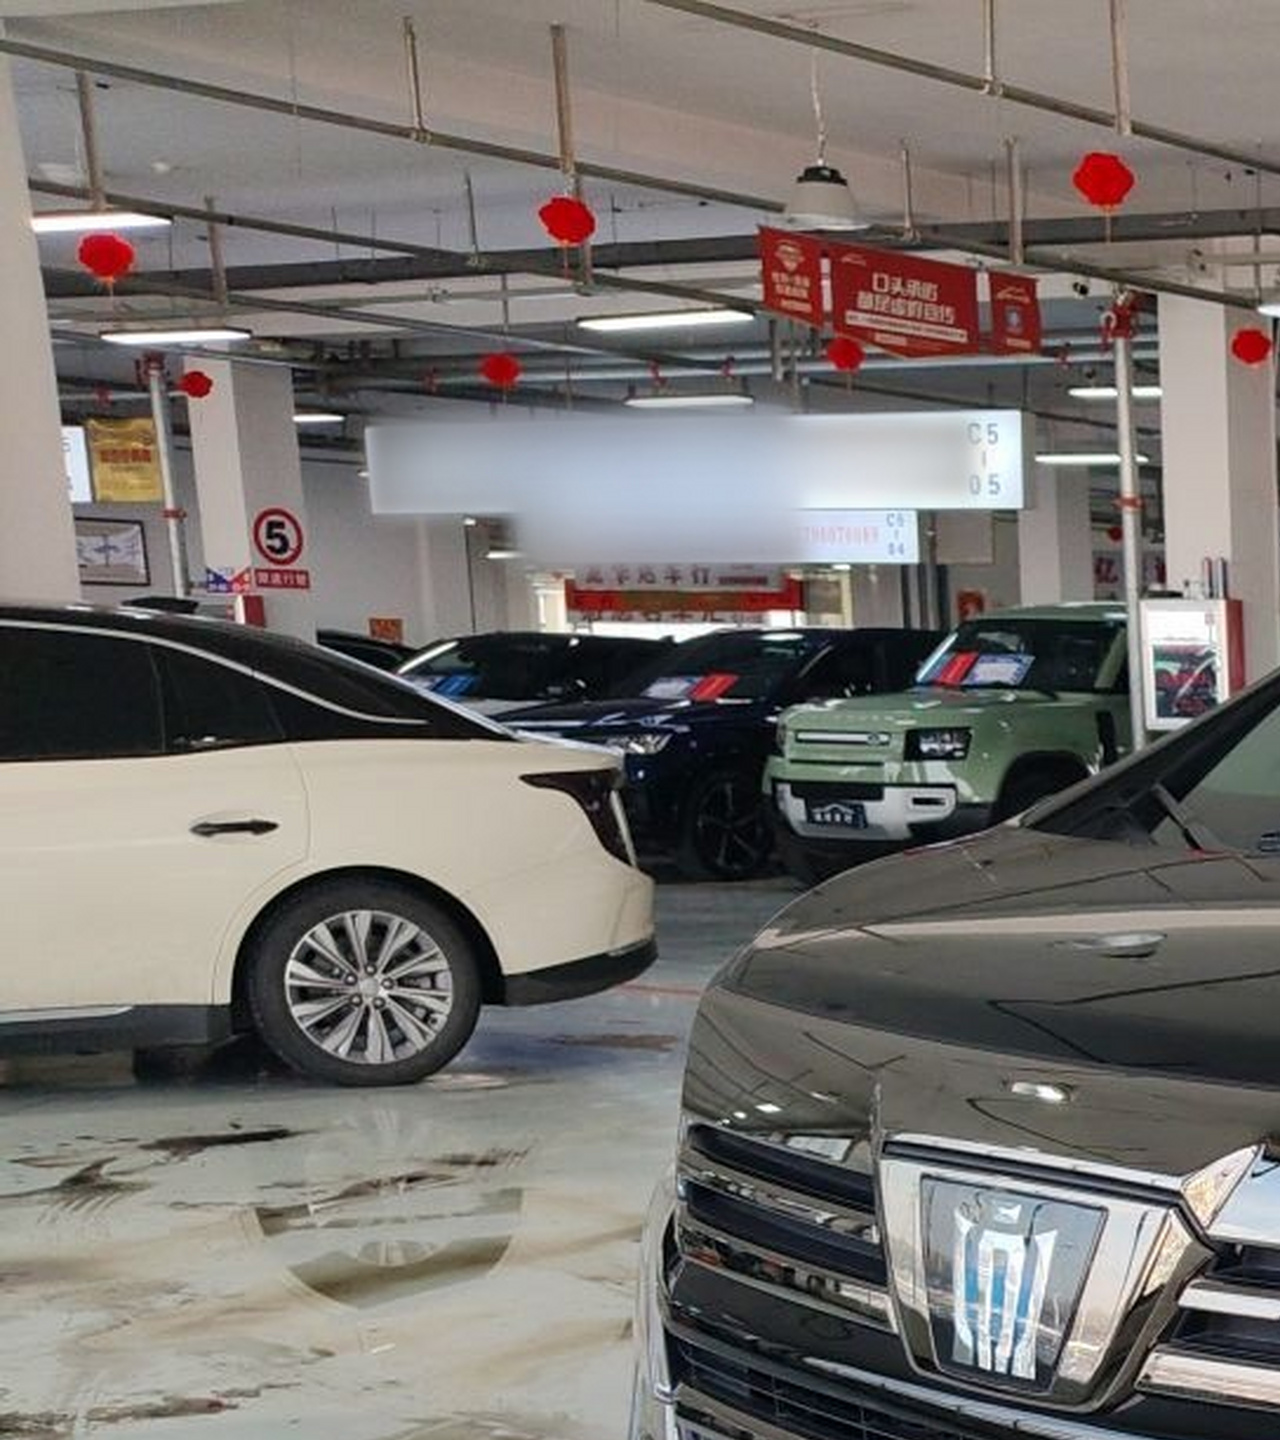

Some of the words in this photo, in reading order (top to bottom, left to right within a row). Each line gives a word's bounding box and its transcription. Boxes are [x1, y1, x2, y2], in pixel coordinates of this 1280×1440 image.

[967, 422, 999, 445] C5
[969, 473, 1001, 496] 05
[265, 520, 290, 555] 5
